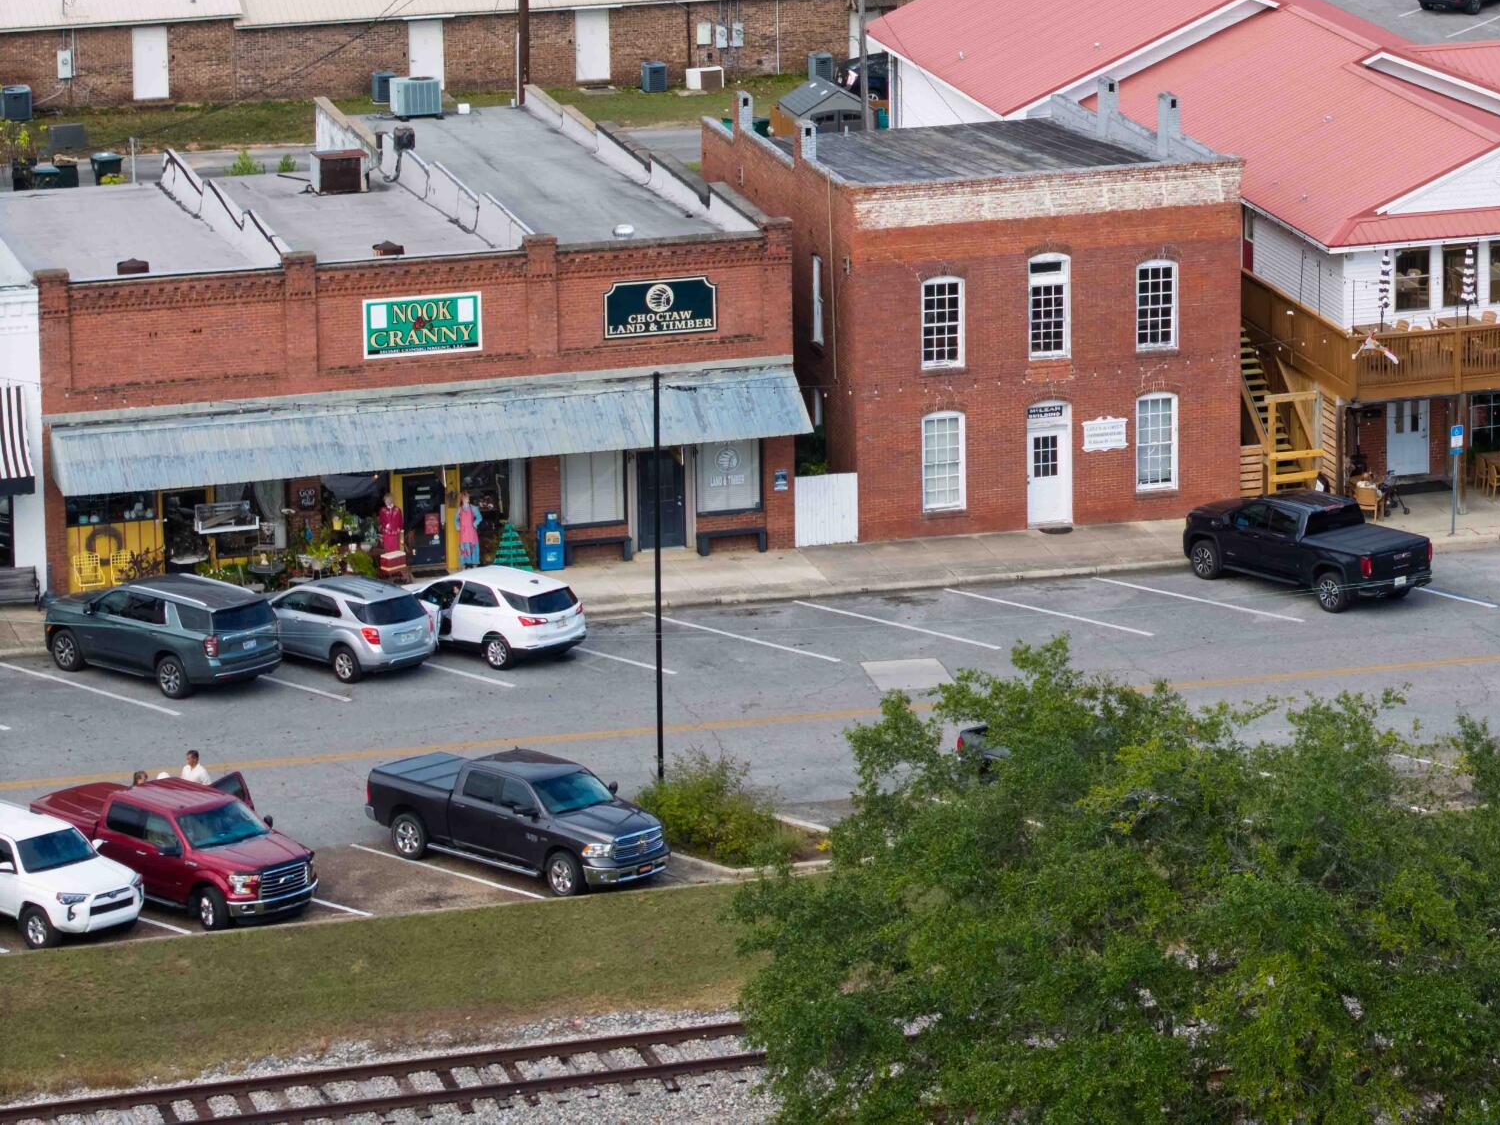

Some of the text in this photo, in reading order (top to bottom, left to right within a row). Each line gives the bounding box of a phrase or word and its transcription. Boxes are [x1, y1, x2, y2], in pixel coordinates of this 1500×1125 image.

[391, 300, 453, 324] NOOK
[628, 310, 693, 324] CHOCTAW
[609, 318, 713, 335] LAND & TIMBER
[370, 324, 474, 348] CRANNY
[710, 475, 722, 487] LAND
